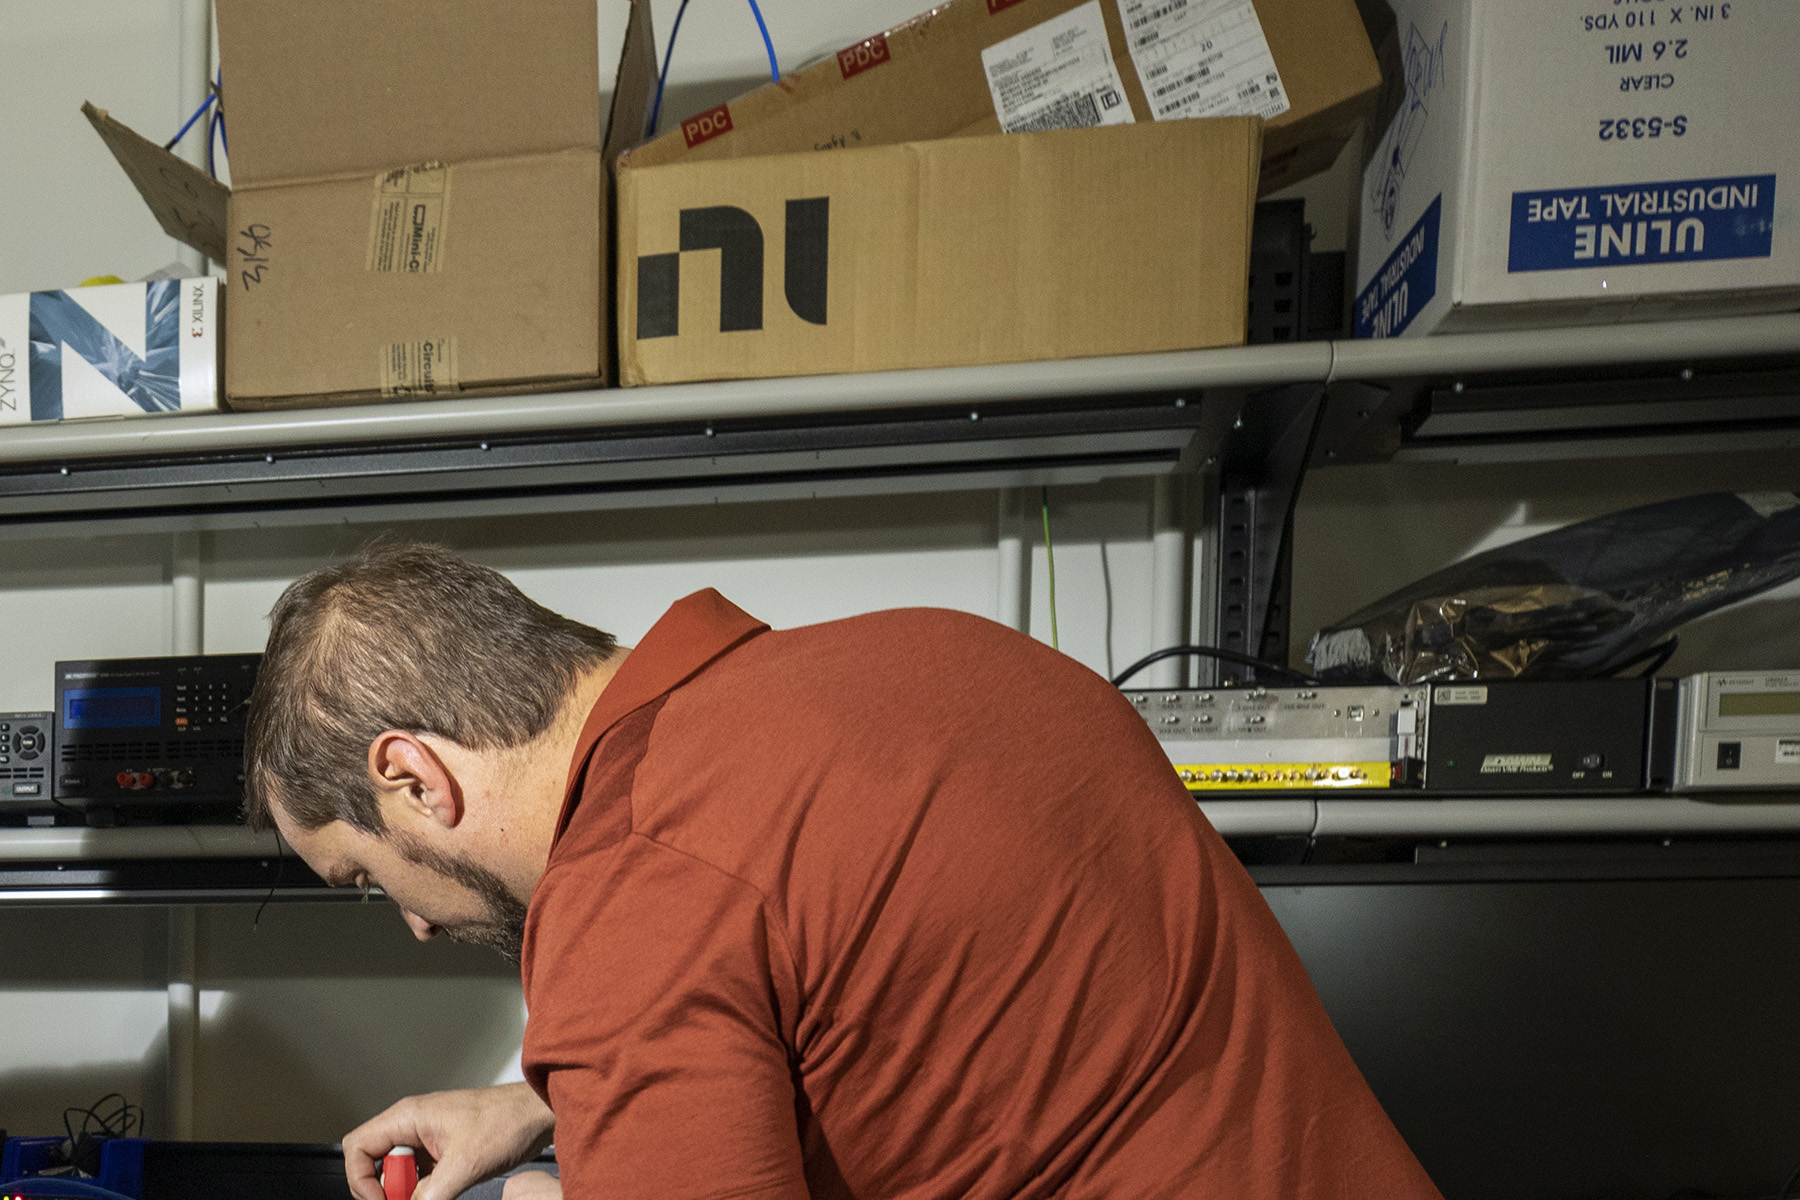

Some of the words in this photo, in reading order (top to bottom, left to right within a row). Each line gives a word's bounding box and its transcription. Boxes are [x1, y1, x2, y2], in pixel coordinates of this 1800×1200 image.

[1580, 13, 1619, 31] YDS.
[1626, 10, 1655, 28] 110
[1670, 7, 1683, 24] X
[1690, 5, 1715, 21] IN.
[1721, 3, 1731, 20] 3
[842, 40, 885, 72] PDC
[1605, 43, 1643, 64] MIL
[1653, 39, 1688, 60] 2.6
[1620, 73, 1675, 92] CLEAR
[685, 110, 728, 142] PDC
[1599, 115, 1688, 140] S-5332
[1527, 196, 1590, 222] TAPE
[1600, 183, 1759, 217] INDUSTRIAL
[1574, 217, 1705, 260] ULINE
[1381, 226, 1424, 298] INDUSTRIAL
[192, 283, 203, 323] XILINX
